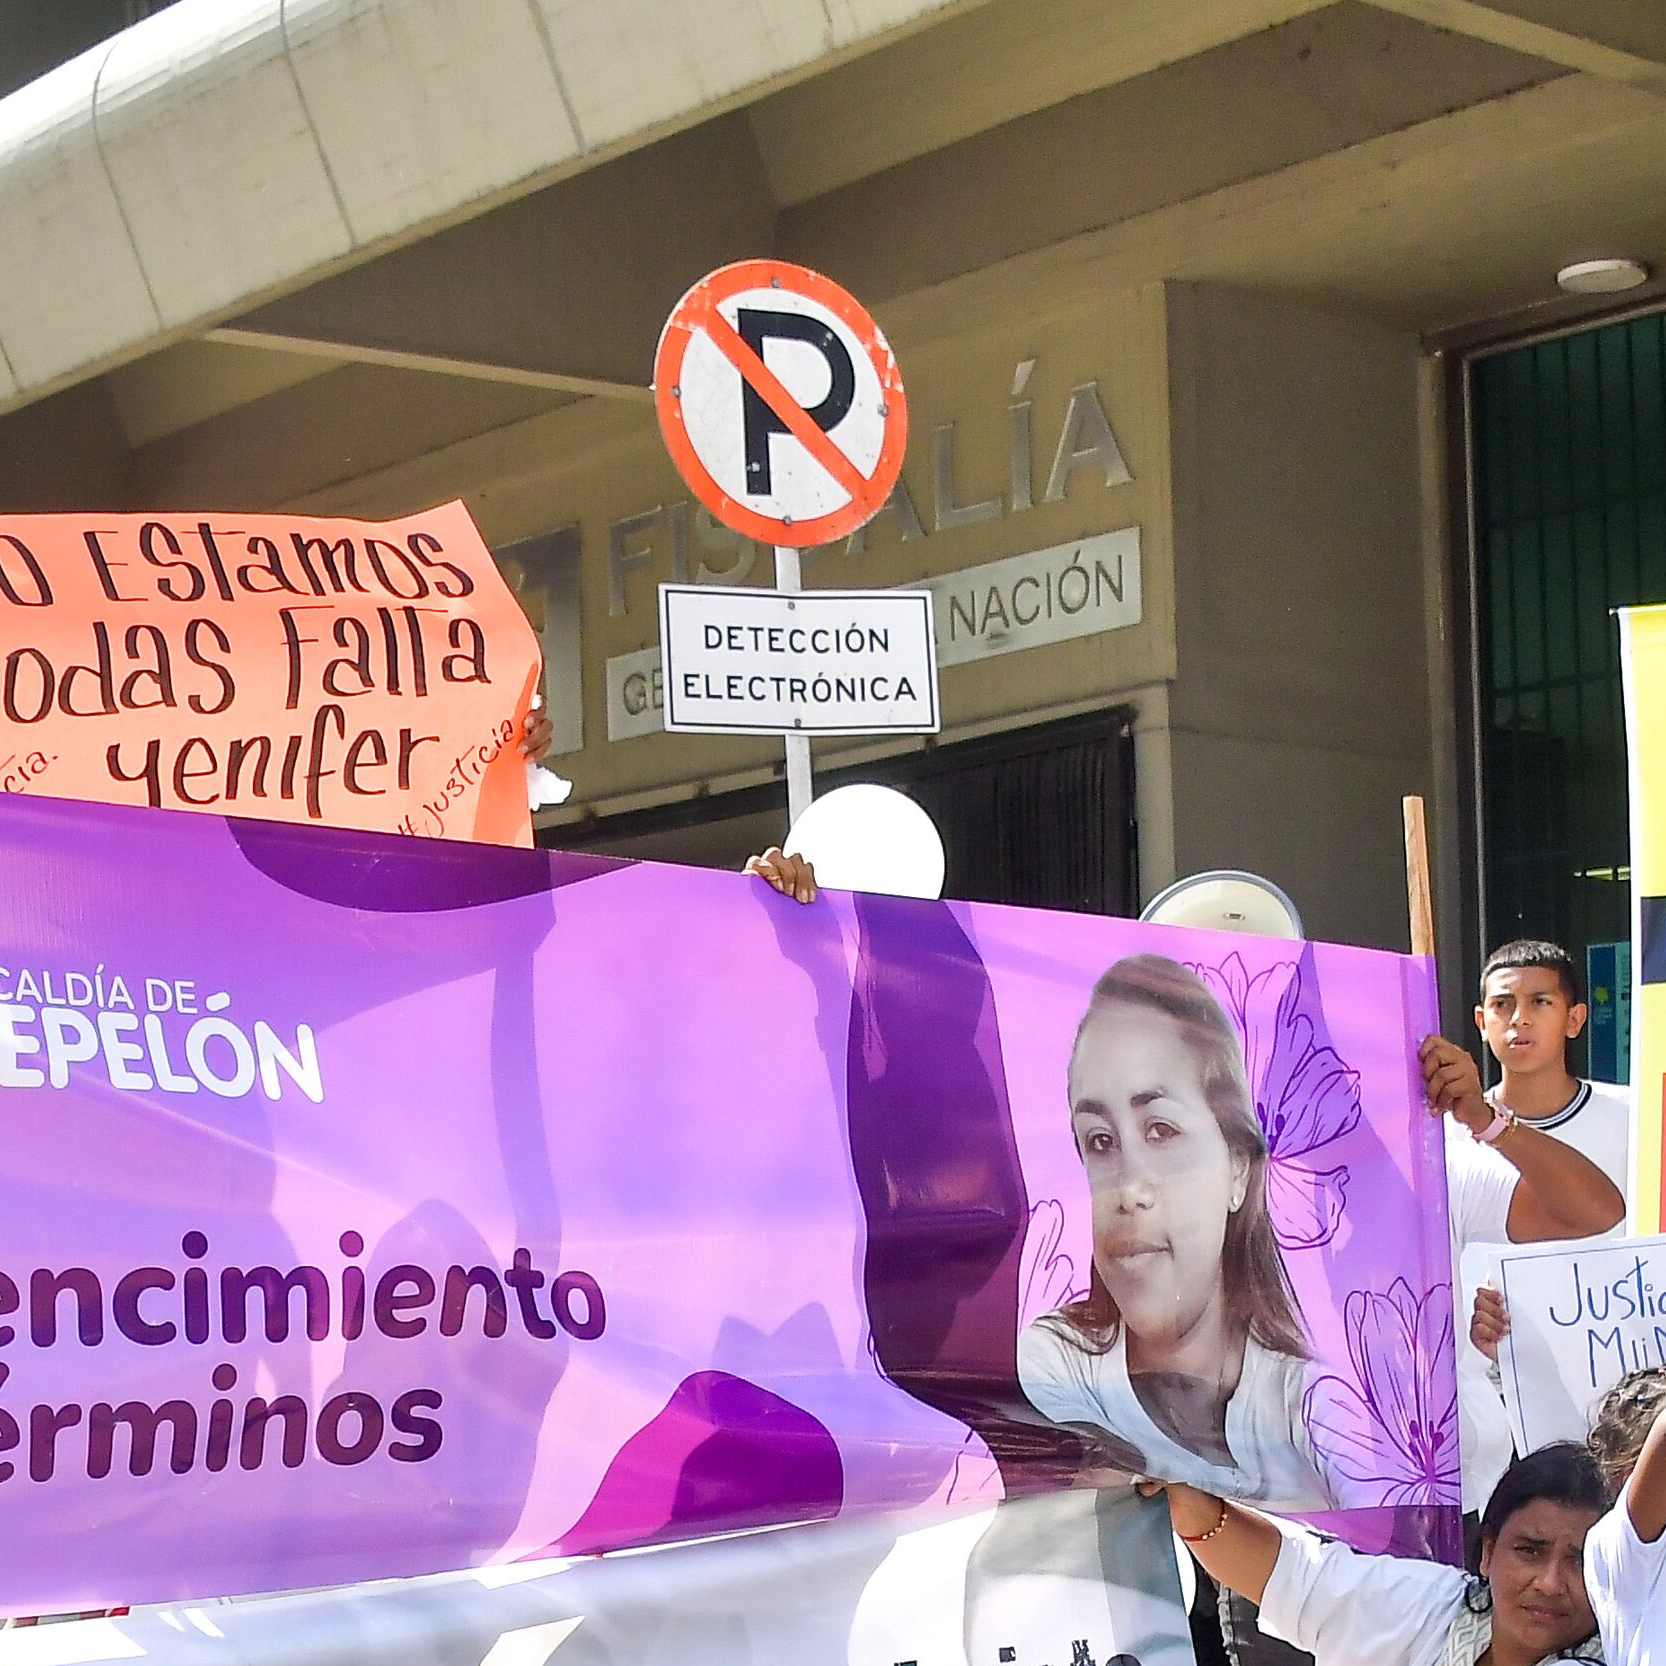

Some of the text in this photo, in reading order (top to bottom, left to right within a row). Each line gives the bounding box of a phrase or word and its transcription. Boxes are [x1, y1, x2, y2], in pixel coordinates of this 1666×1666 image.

[949, 550, 1126, 641] NACIÓN
[703, 622, 890, 654] DETECCIÓN
[682, 671, 918, 703] ELECTRÓNICA
[145, 977, 199, 1014] DE
